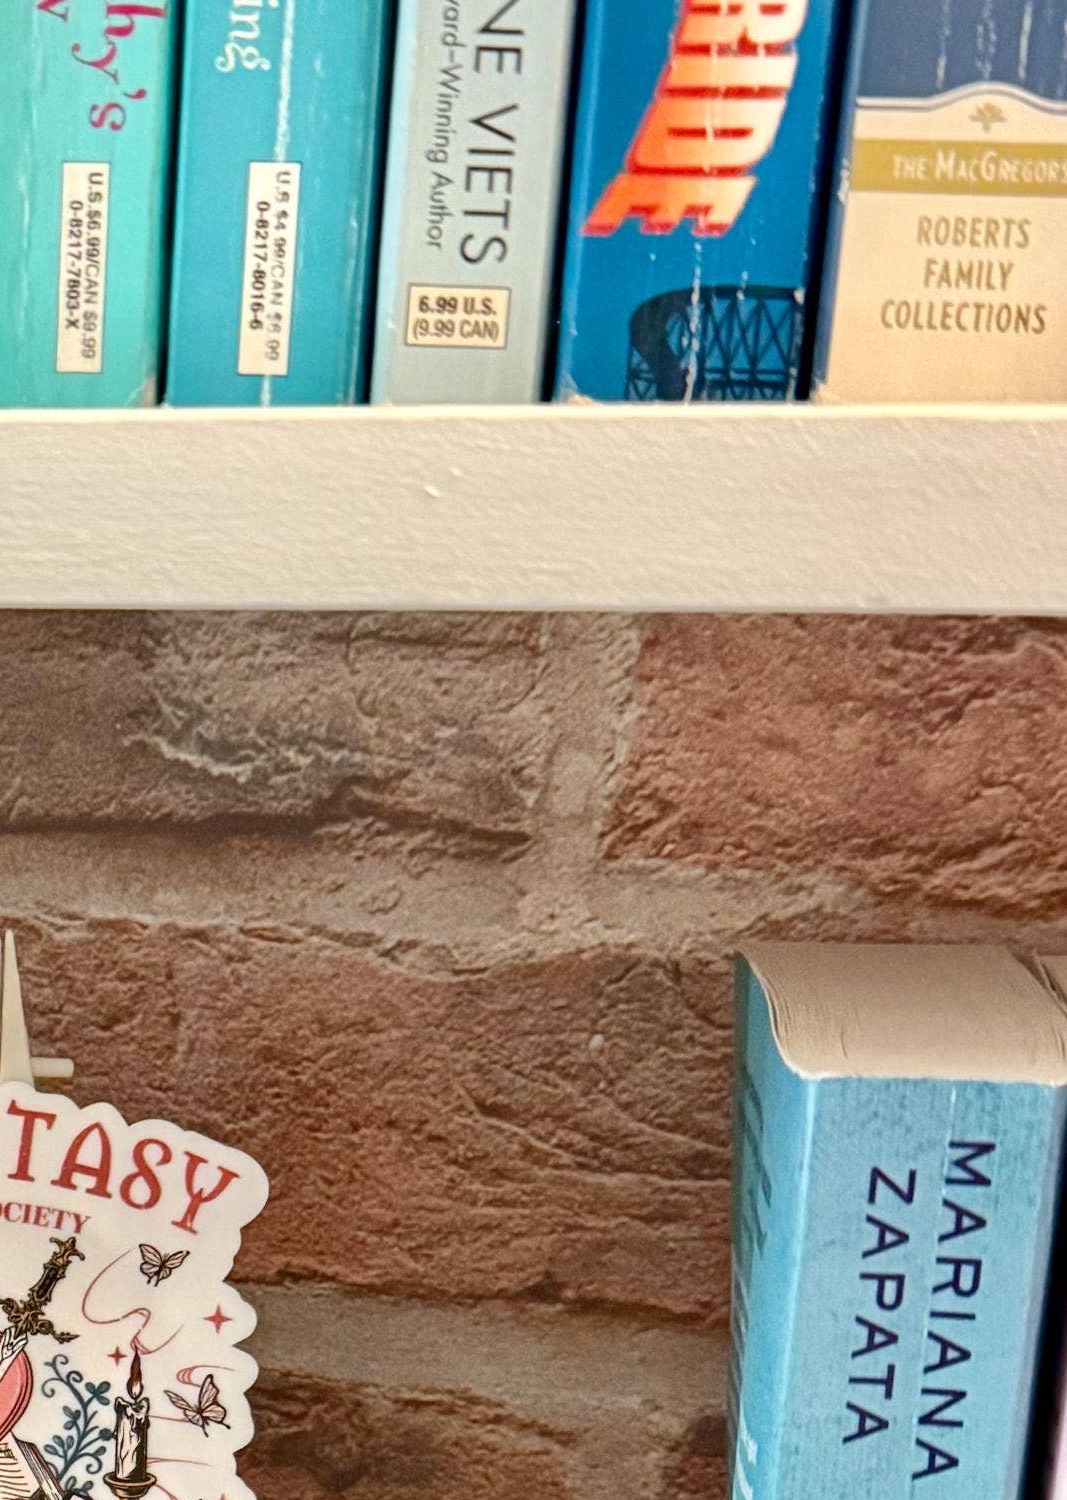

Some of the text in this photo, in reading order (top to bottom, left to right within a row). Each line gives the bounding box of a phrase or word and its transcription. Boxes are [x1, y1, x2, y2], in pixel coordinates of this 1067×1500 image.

[458, 104, 520, 265] VIETS
[892, 154, 928, 181] THE
[427, 171, 455, 250] Author
[917, 215, 1032, 250] ROBERTS
[922, 258, 1015, 292] FAMILY
[418, 295, 497, 316] 6.99 U.S.
[879, 297, 1048, 336] COLLECTIONS
[413, 317, 499, 342] (9.99 CAN)
[841, 1166, 918, 1445] ZAPATA
[910, 1139, 998, 1483] MARIANA
